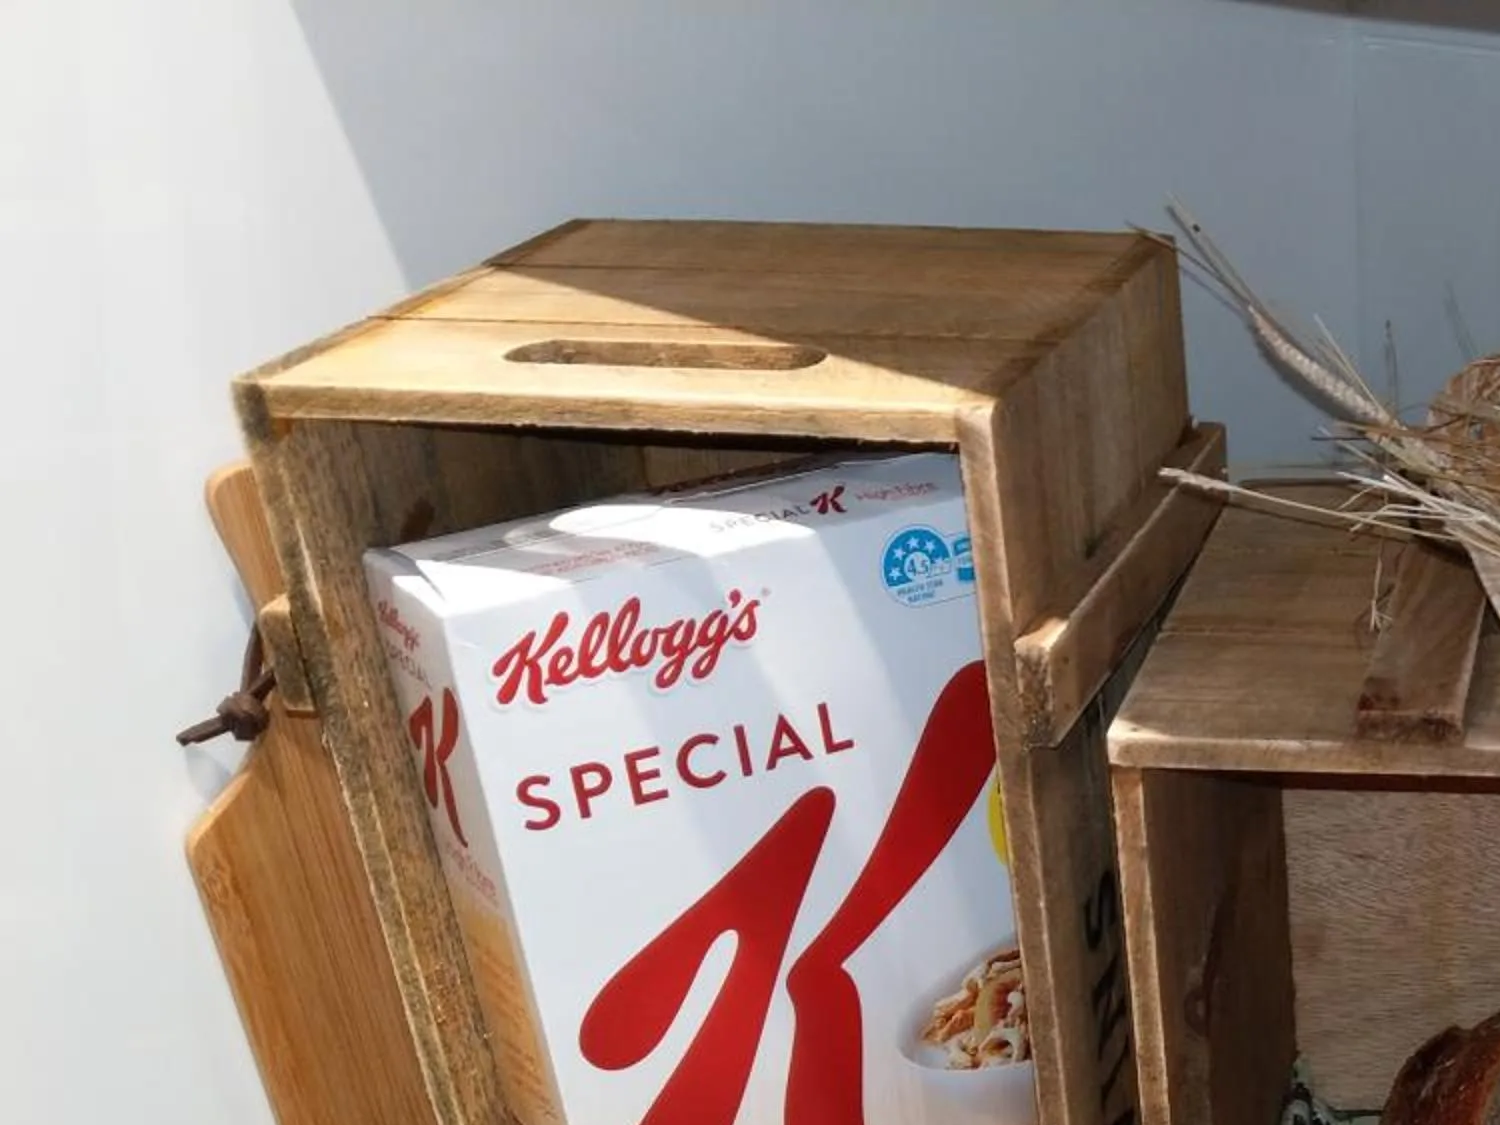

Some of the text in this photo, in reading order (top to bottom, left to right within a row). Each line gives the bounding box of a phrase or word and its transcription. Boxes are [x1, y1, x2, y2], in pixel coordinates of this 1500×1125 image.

[809, 485, 847, 514] K
[491, 588, 761, 705] Kellogg's
[409, 687, 469, 848] K
[515, 702, 856, 831] SPECIAL
